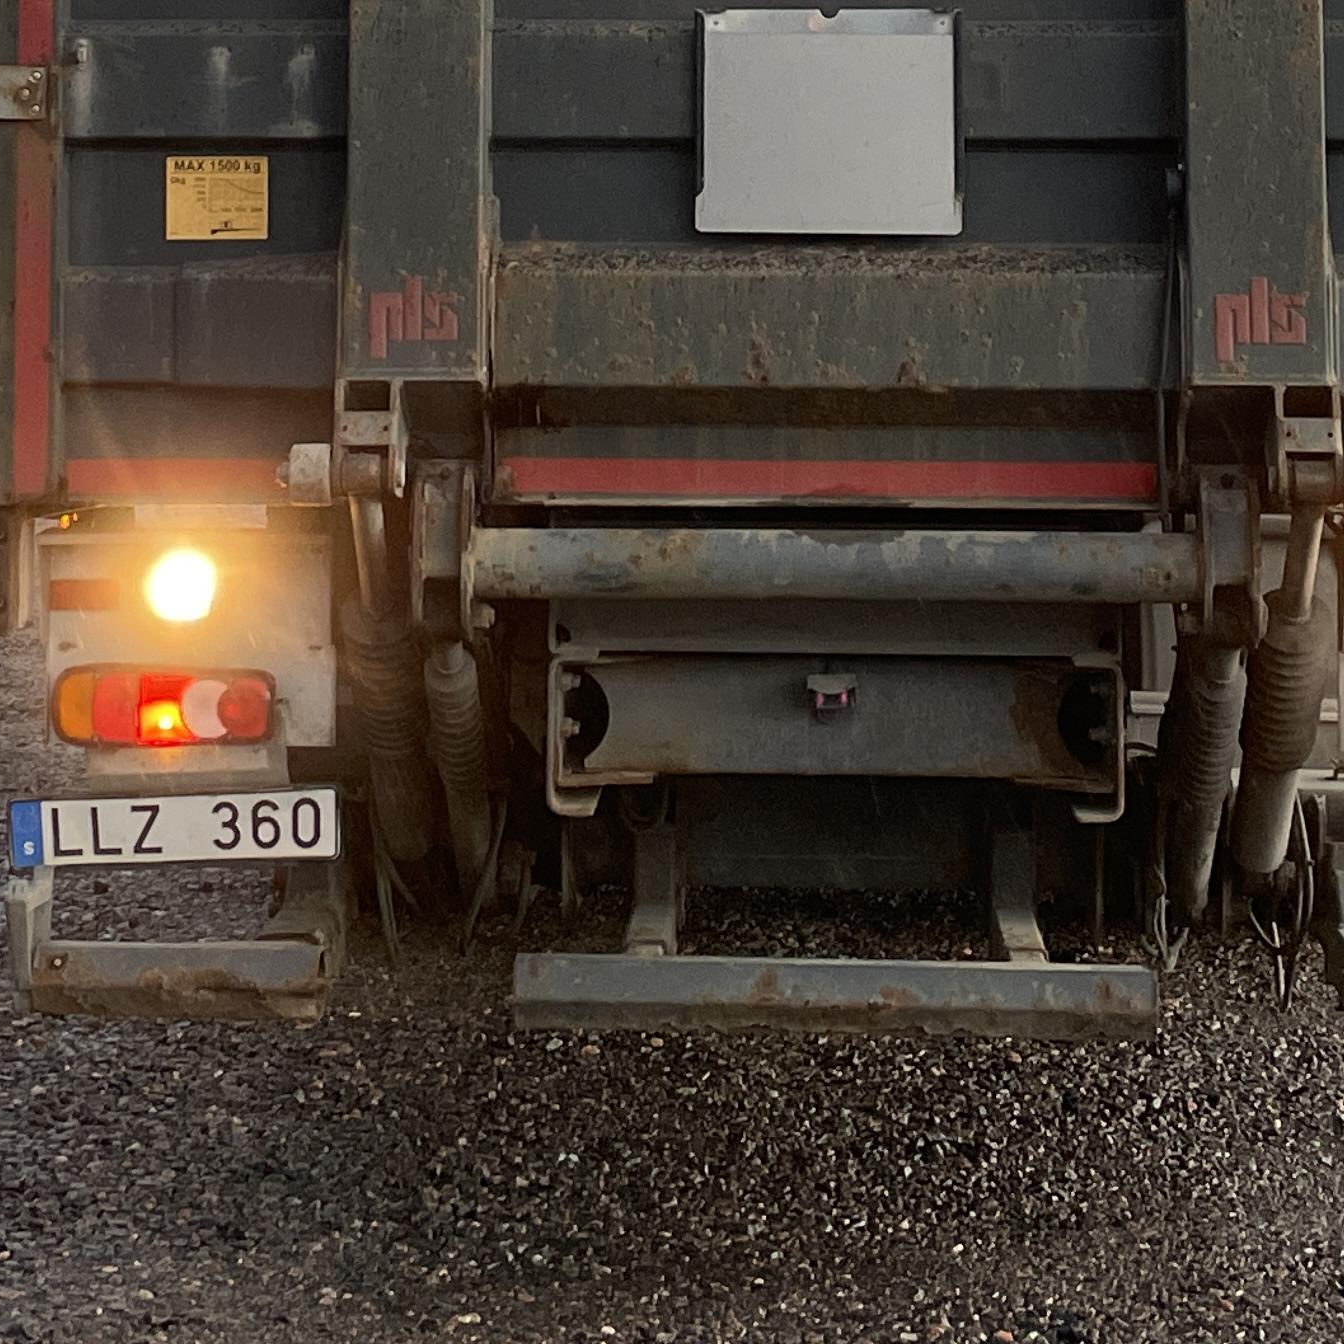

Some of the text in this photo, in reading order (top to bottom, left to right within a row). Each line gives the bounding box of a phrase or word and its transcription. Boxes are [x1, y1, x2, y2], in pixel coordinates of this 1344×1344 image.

[174, 159, 261, 175] MAX 1500 kg
[370, 275, 458, 359] pls
[1215, 276, 1308, 362] pls
[23, 841, 35, 855] S
[51, 797, 321, 857] LLZ 360
